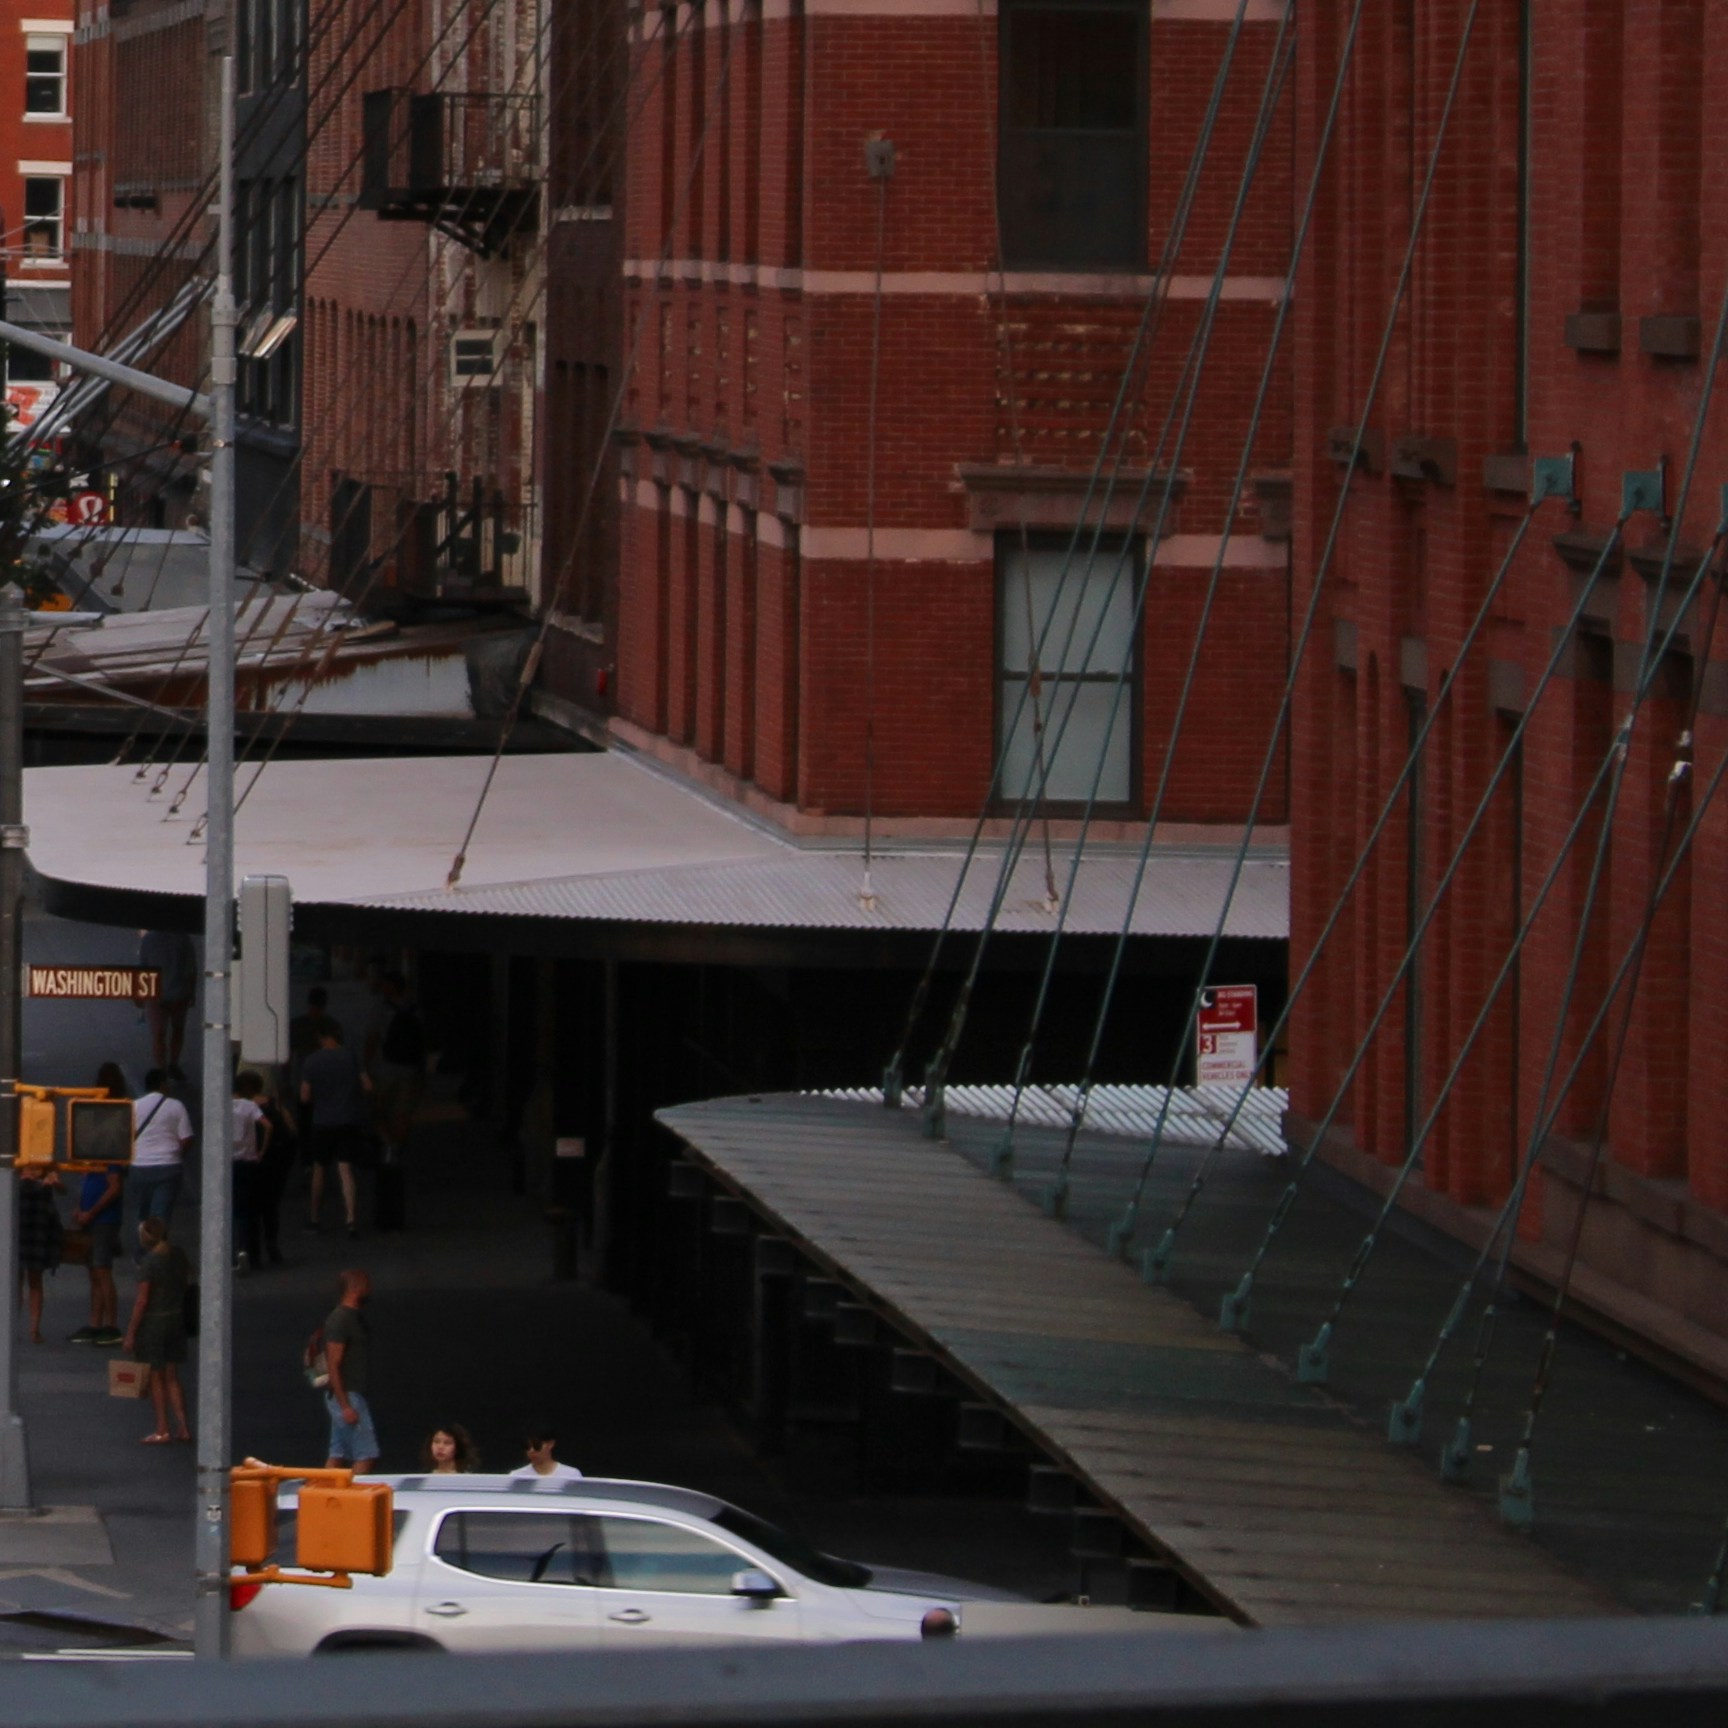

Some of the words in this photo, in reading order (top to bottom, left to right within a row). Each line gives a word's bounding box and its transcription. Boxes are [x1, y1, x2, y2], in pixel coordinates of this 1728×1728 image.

[31, 969, 132, 997] WASHINGTON
[138, 971, 158, 997] ST
[1202, 1035, 1213, 1053] 3
